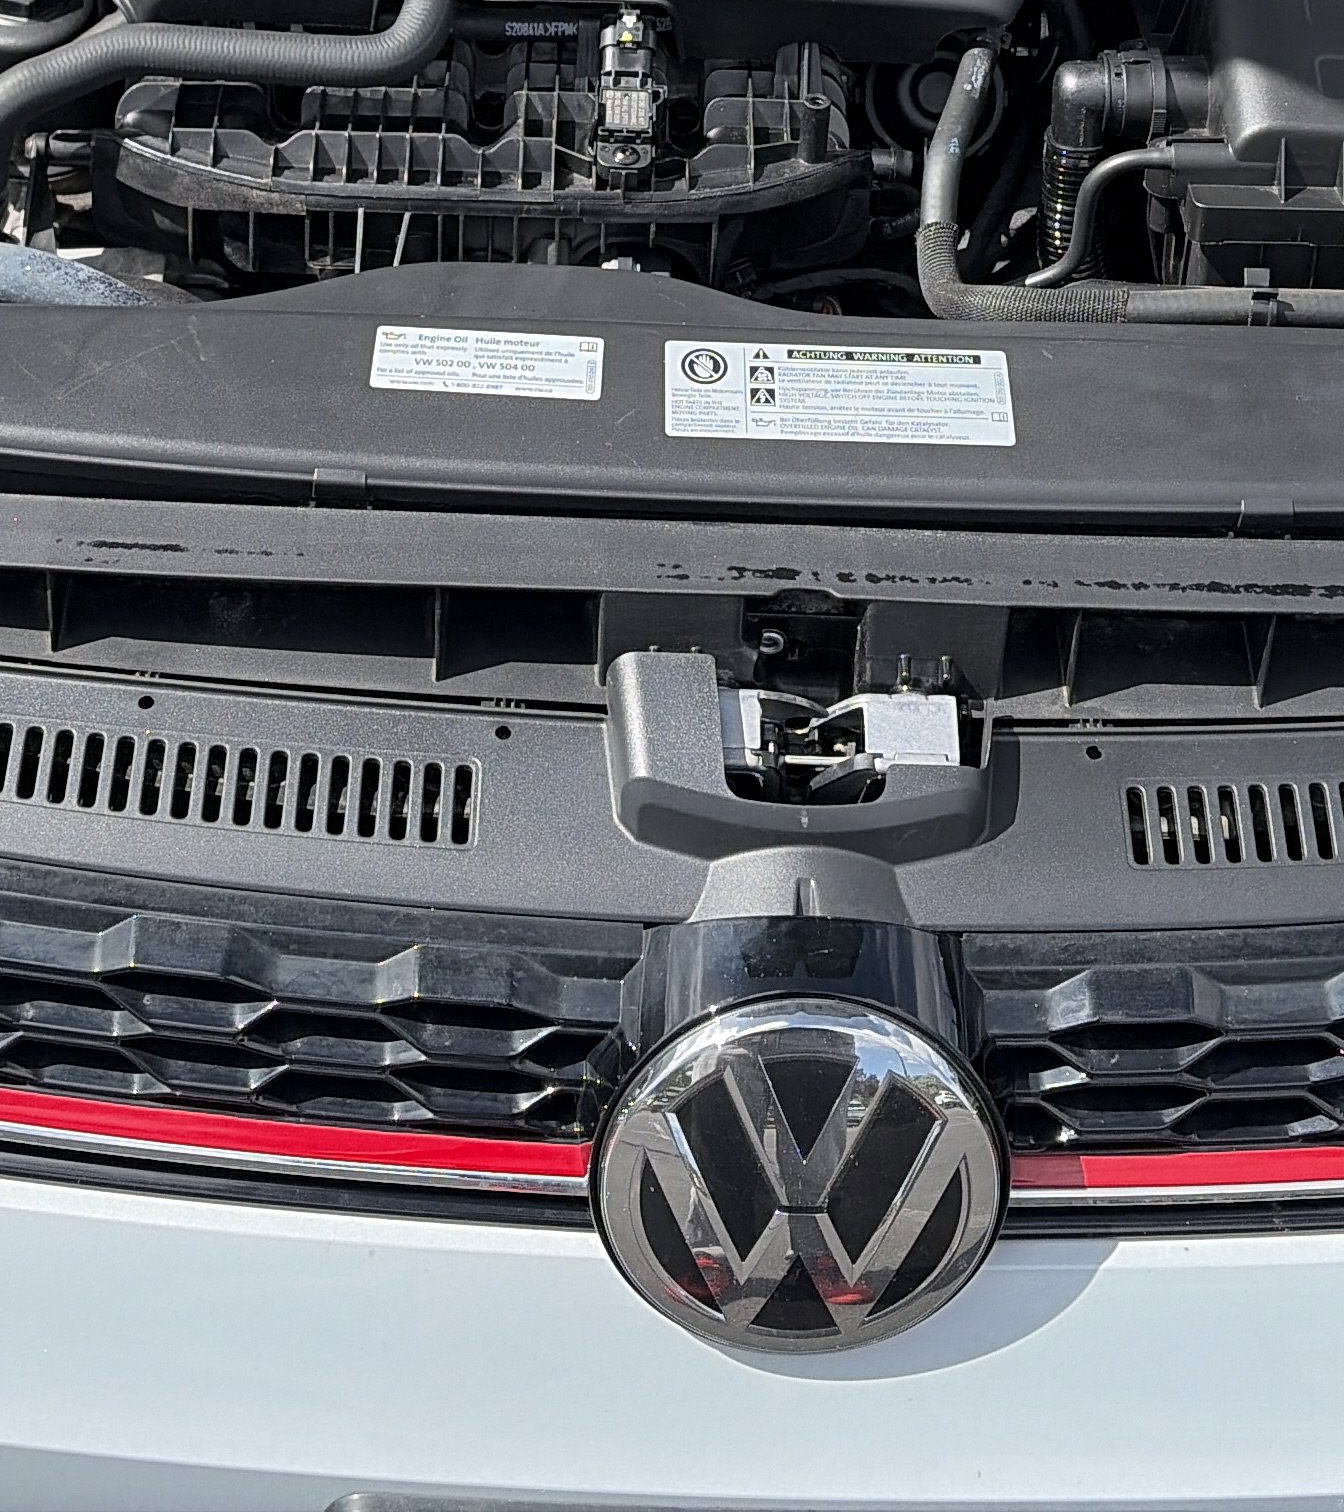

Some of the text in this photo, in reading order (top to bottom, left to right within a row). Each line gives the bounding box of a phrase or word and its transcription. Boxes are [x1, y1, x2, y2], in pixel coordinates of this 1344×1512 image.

[419, 334, 541, 348] Engine Oil Huile moteur
[791, 350, 975, 364] ACHTUNG WARNING ATTENTION
[414, 358, 433, 366] VW
[435, 359, 455, 367] 502
[478, 361, 497, 370] VW
[499, 362, 519, 371] 504
[520, 363, 536, 372] 00
